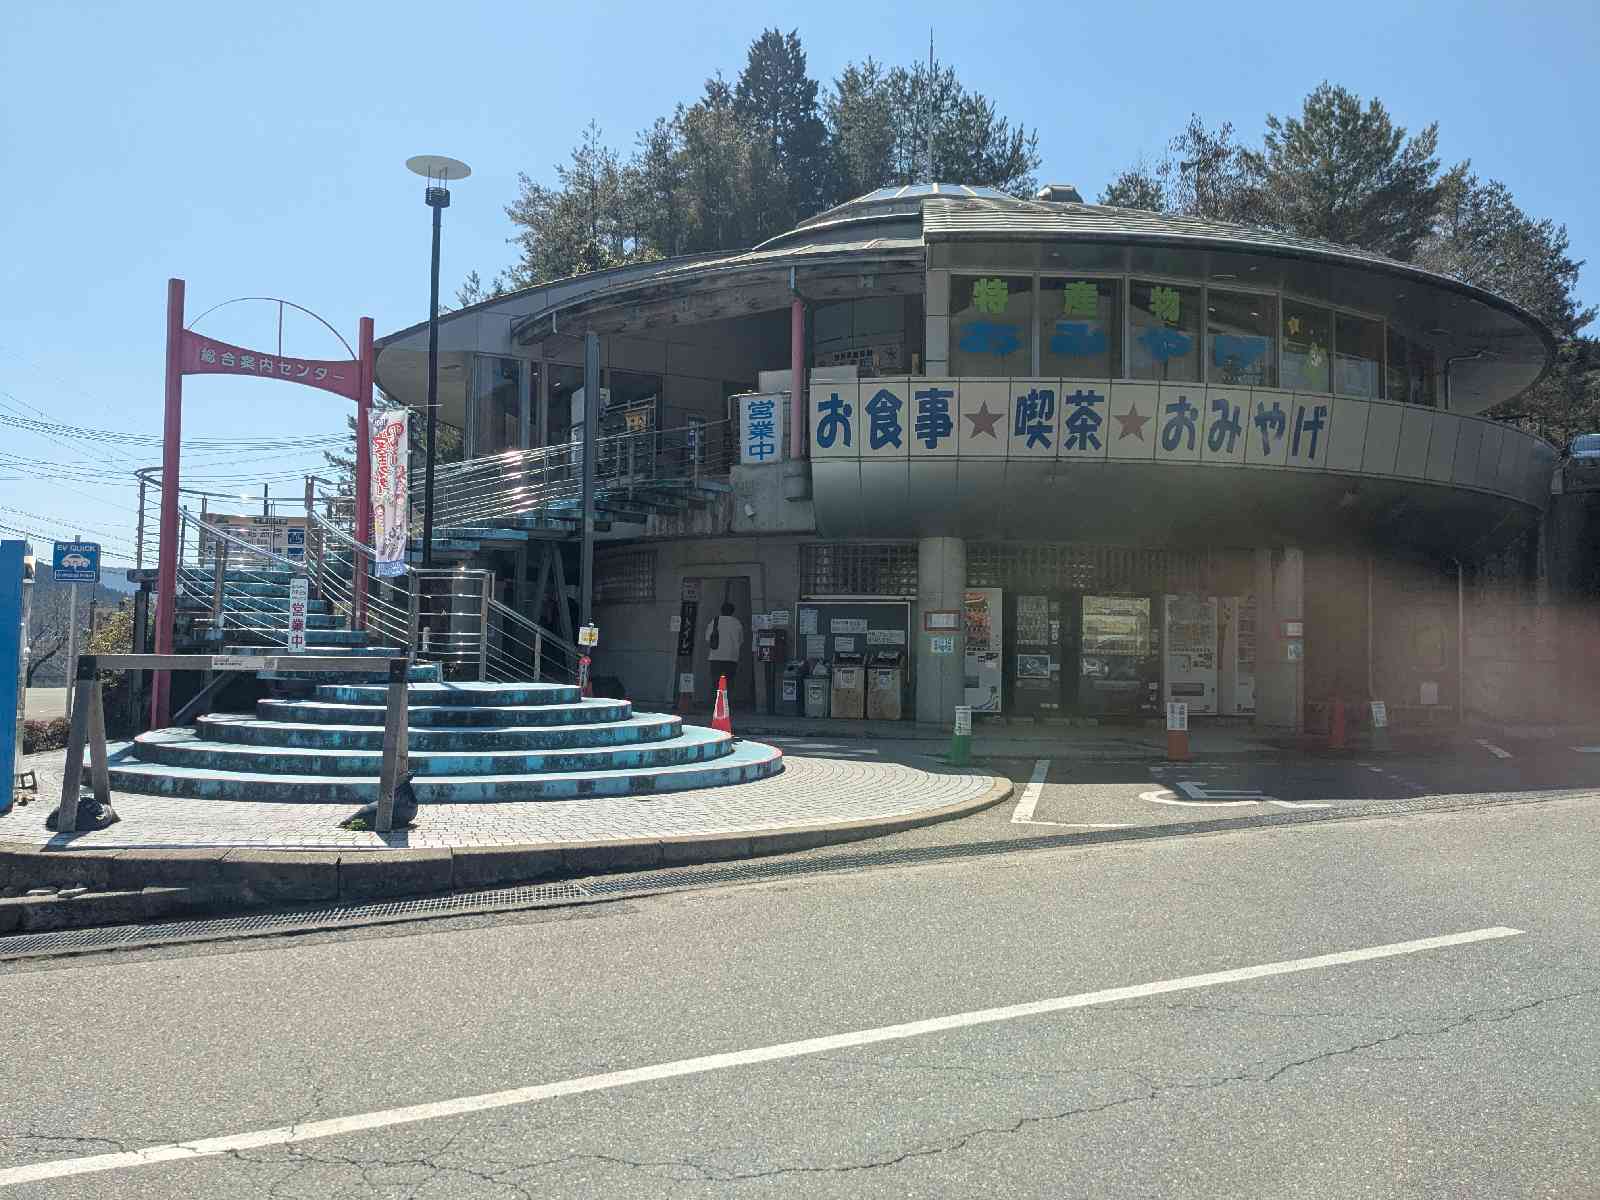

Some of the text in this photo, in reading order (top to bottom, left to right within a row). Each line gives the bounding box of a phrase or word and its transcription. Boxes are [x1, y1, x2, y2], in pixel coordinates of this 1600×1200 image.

[973, 278, 1181, 321] 特産物
[200, 347, 345, 381] 総合案内センター
[748, 400, 775, 461] 営業中
[816, 387, 1328, 459] お食事 喫茶 おみやげ
[57, 544, 97, 553] EV QUICK
[291, 603, 305, 648] 営業中
